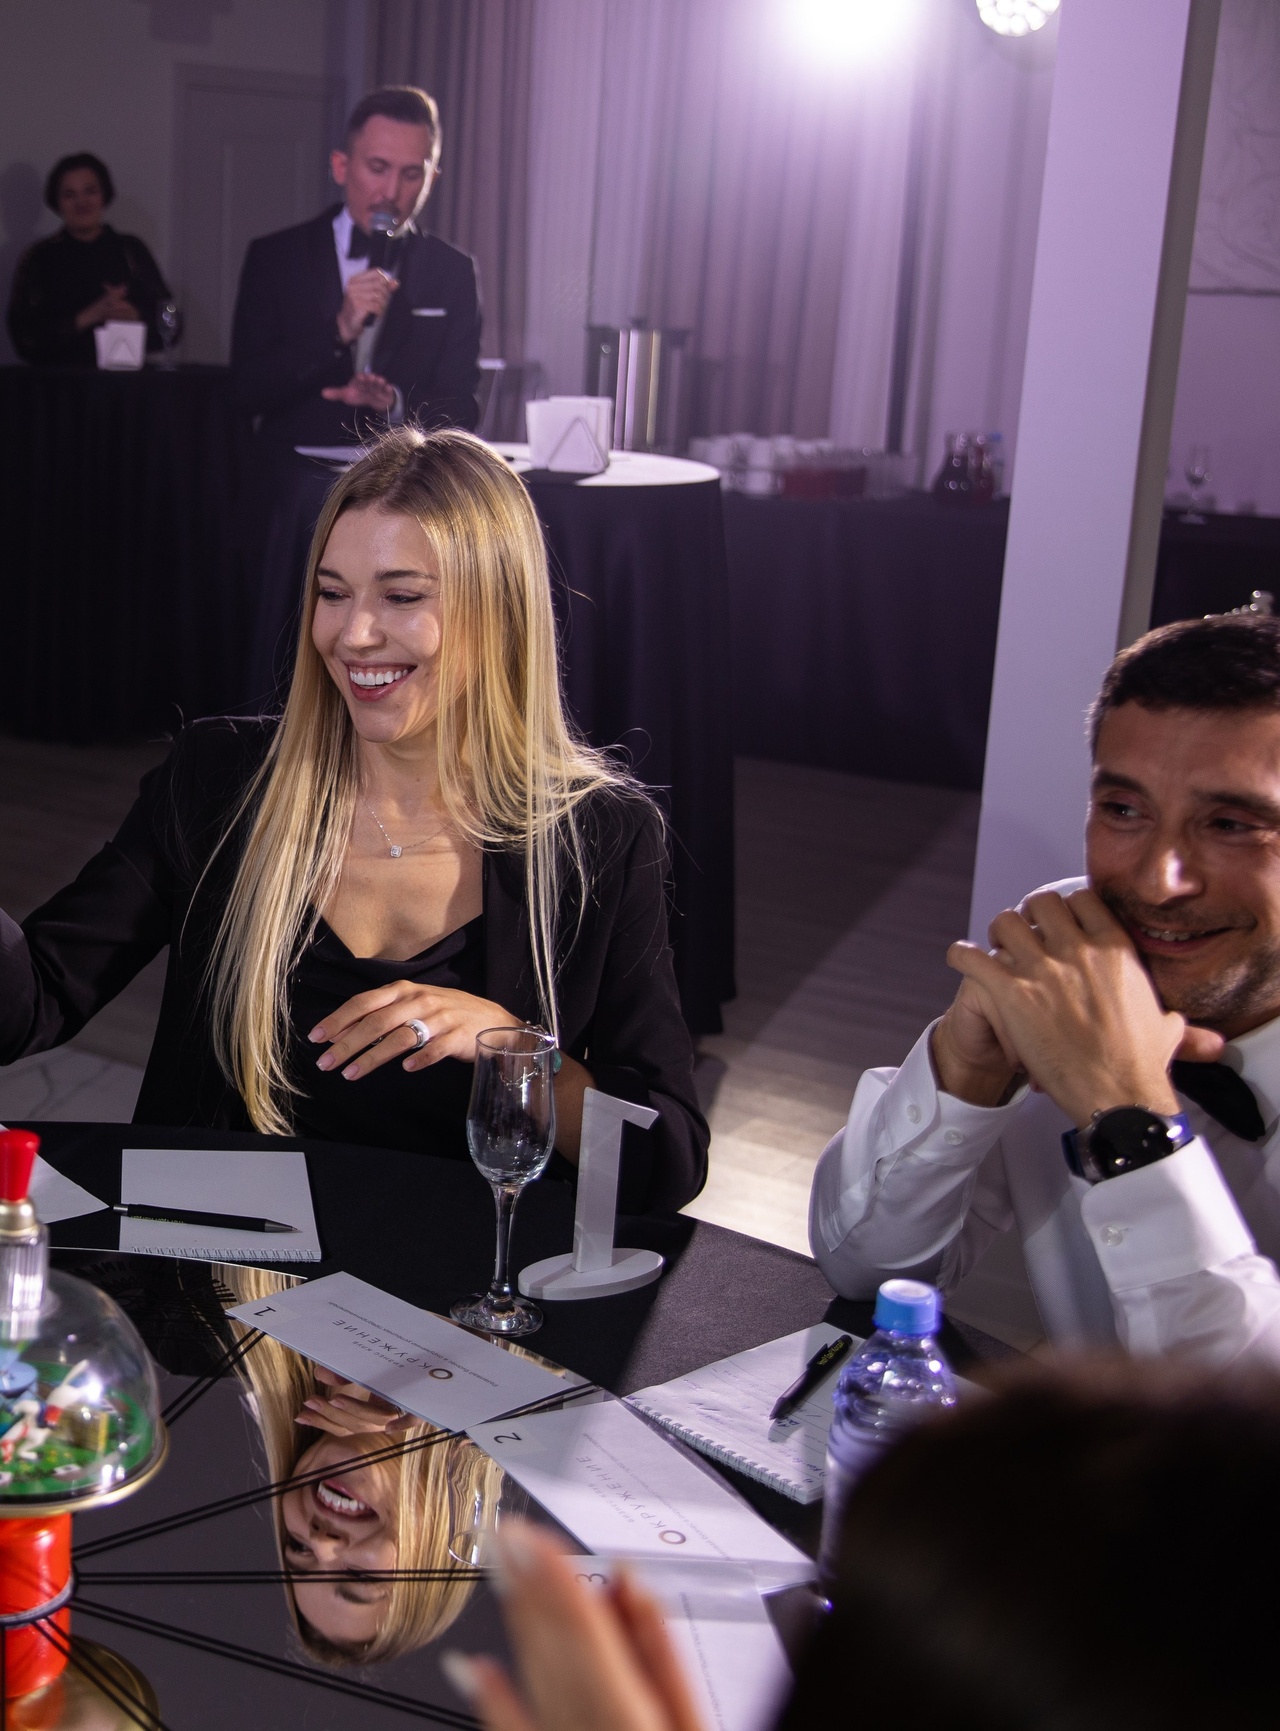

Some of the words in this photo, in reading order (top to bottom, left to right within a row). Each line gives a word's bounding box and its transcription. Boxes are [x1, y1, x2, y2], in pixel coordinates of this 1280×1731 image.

[253, 1306, 277, 1317] 1
[332, 1319, 453, 1380] ОКРУЖЕНИЕ
[352, 1340, 373, 1352] КЛУБ
[374, 1352, 405, 1368] БИЗНЕС
[493, 1432, 522, 1444] 2
[576, 1456, 686, 1545] ОКРУЖЕНИЕ
[576, 1573, 608, 1585] 3
